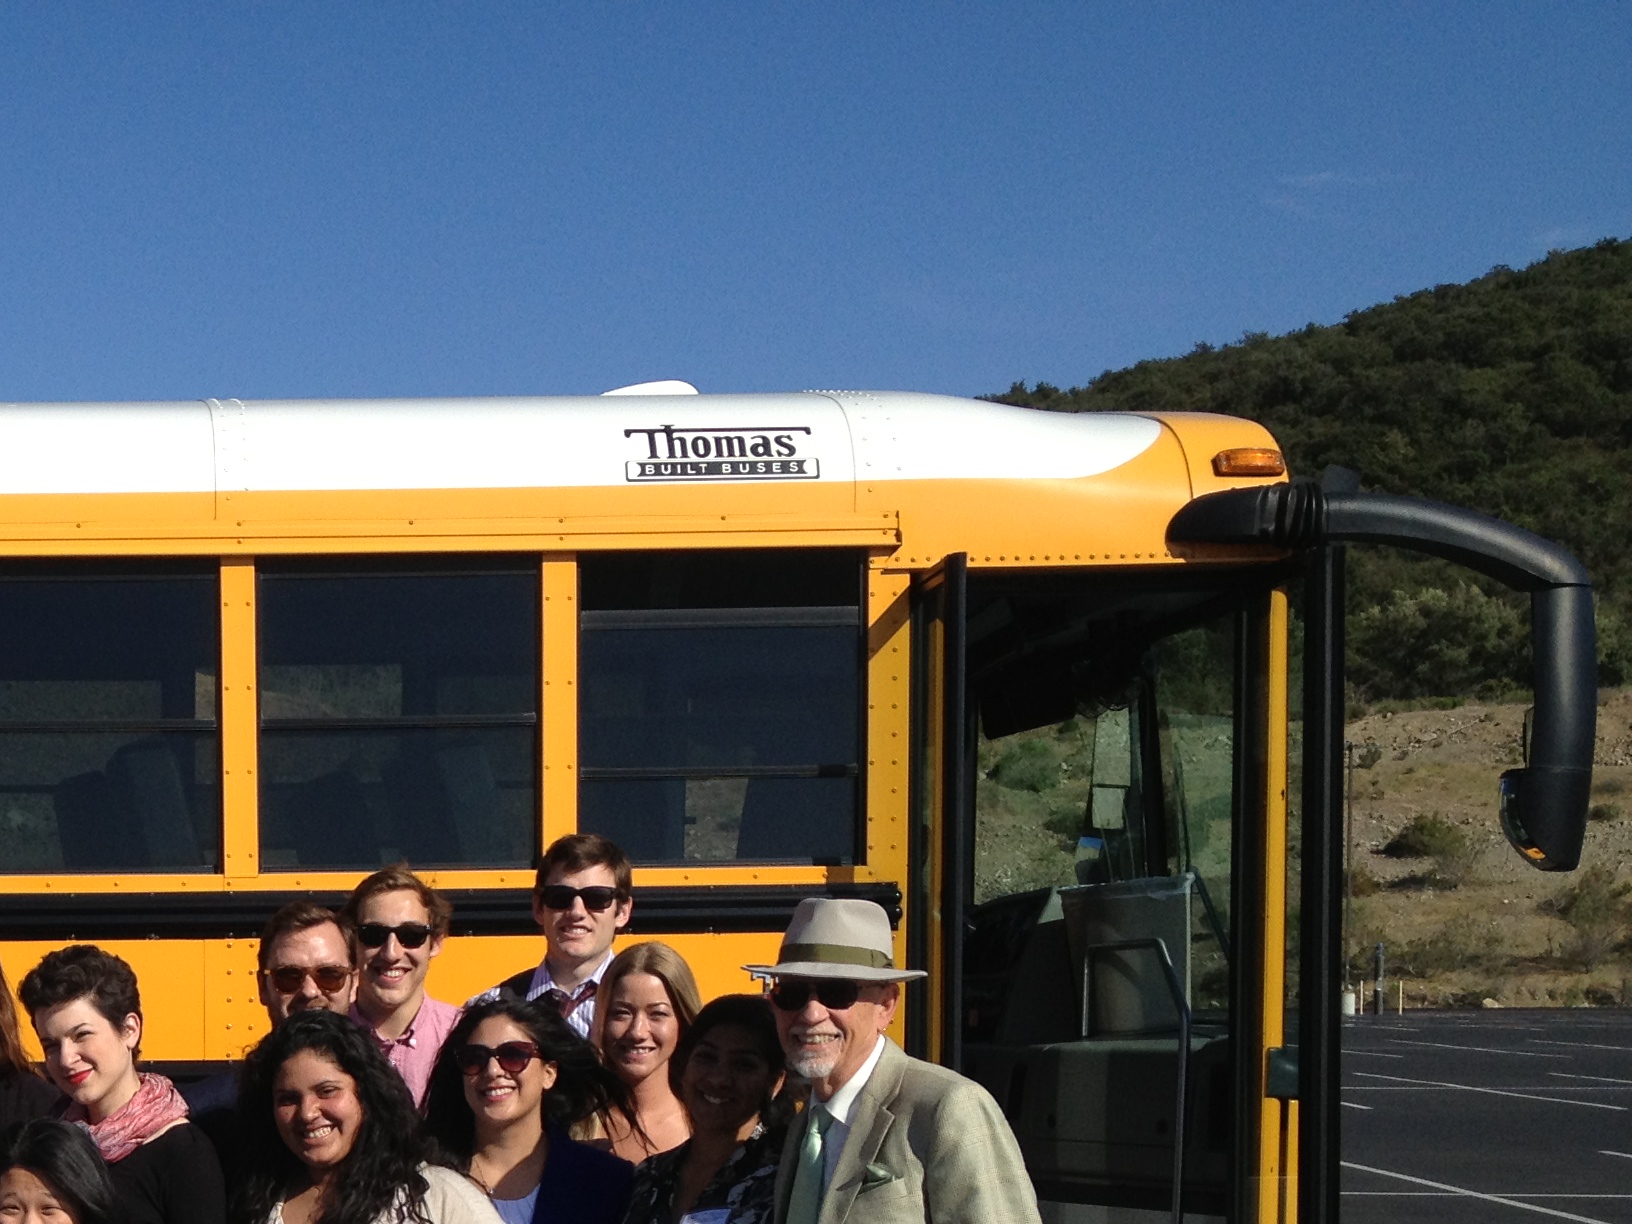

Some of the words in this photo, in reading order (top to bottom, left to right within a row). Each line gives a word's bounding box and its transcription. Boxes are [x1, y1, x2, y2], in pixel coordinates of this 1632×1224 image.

[624, 425, 811, 459] Thomas
[644, 463, 709, 475] BUILT
[721, 462, 799, 474] BUSES
